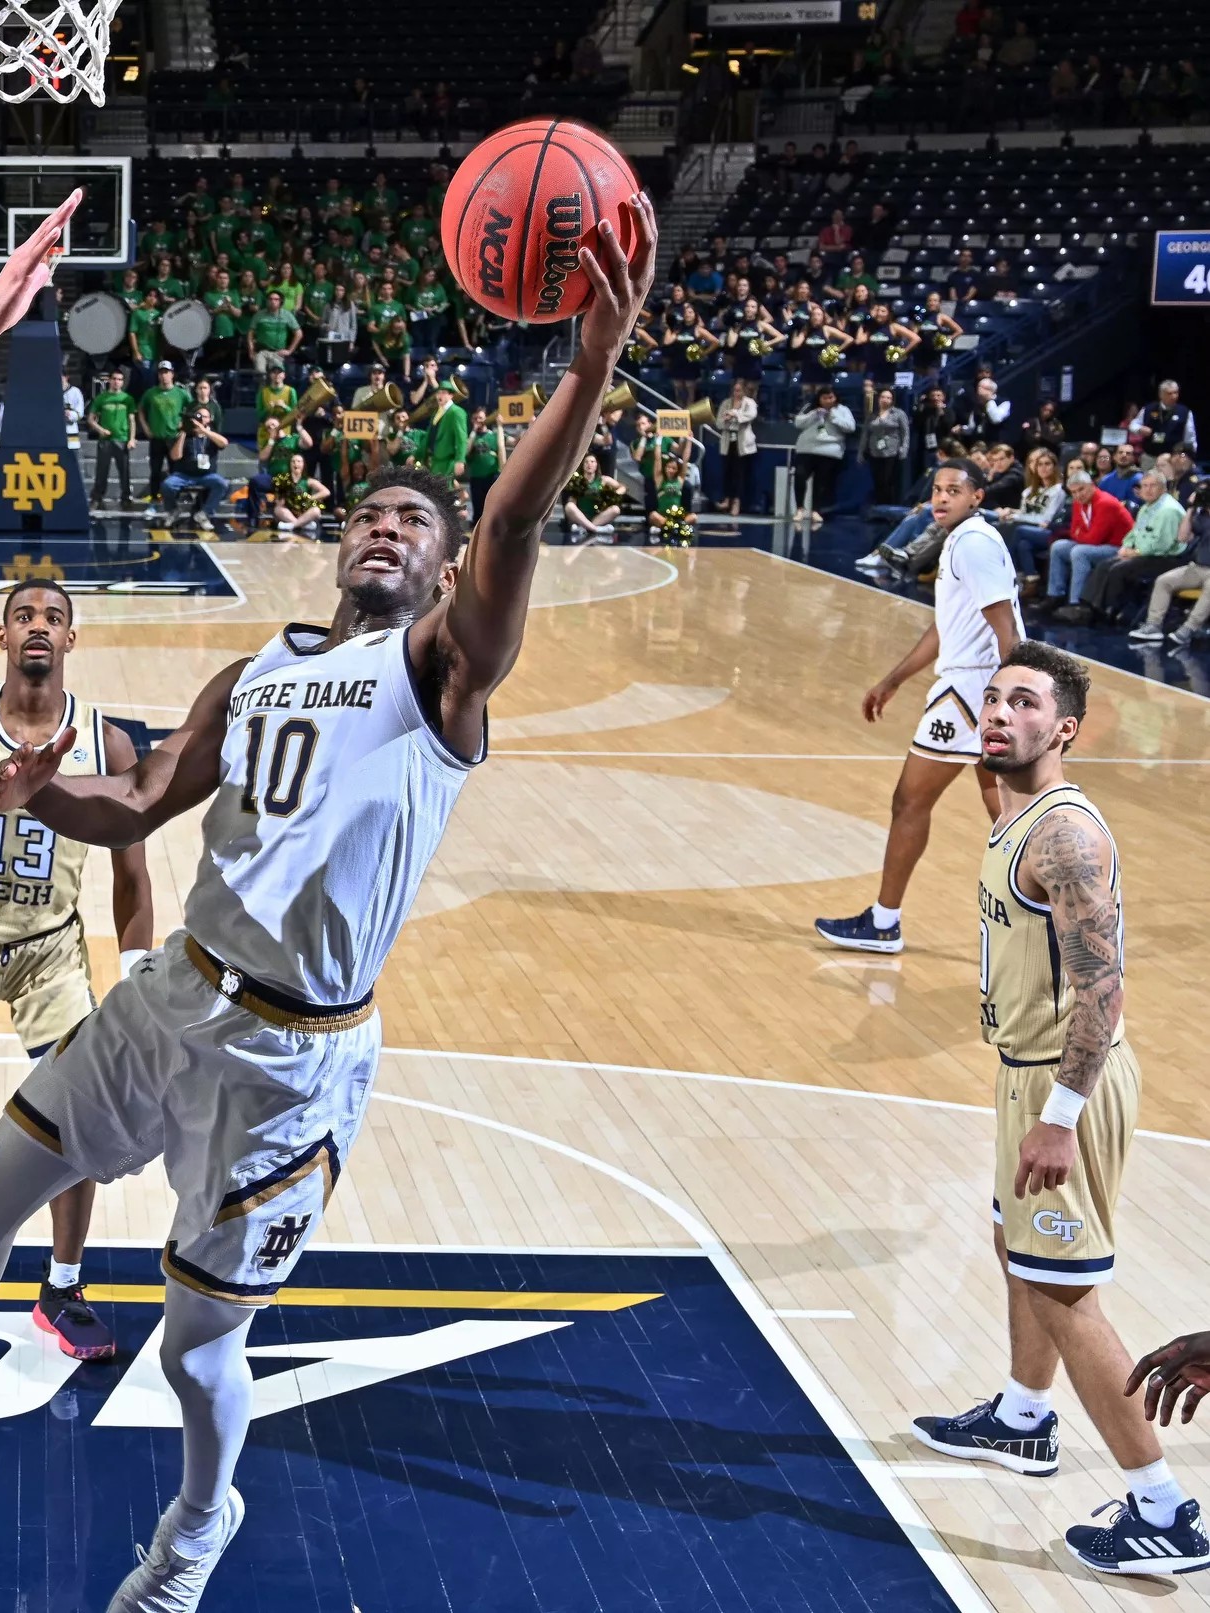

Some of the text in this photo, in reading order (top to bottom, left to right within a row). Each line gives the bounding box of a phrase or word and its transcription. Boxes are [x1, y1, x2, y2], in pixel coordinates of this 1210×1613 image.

[478, 207, 513, 299] NCAA
[533, 192, 582, 317] Wilson
[1184, 264, 1210, 294] 4
[347, 418, 374, 432] LET'S
[509, 402, 523, 416] GO
[660, 416, 687, 430] IRISH
[227, 679, 377, 727] NOTRE DAME
[241, 713, 320, 819] 10
[1032, 1209, 1082, 1242] GT
